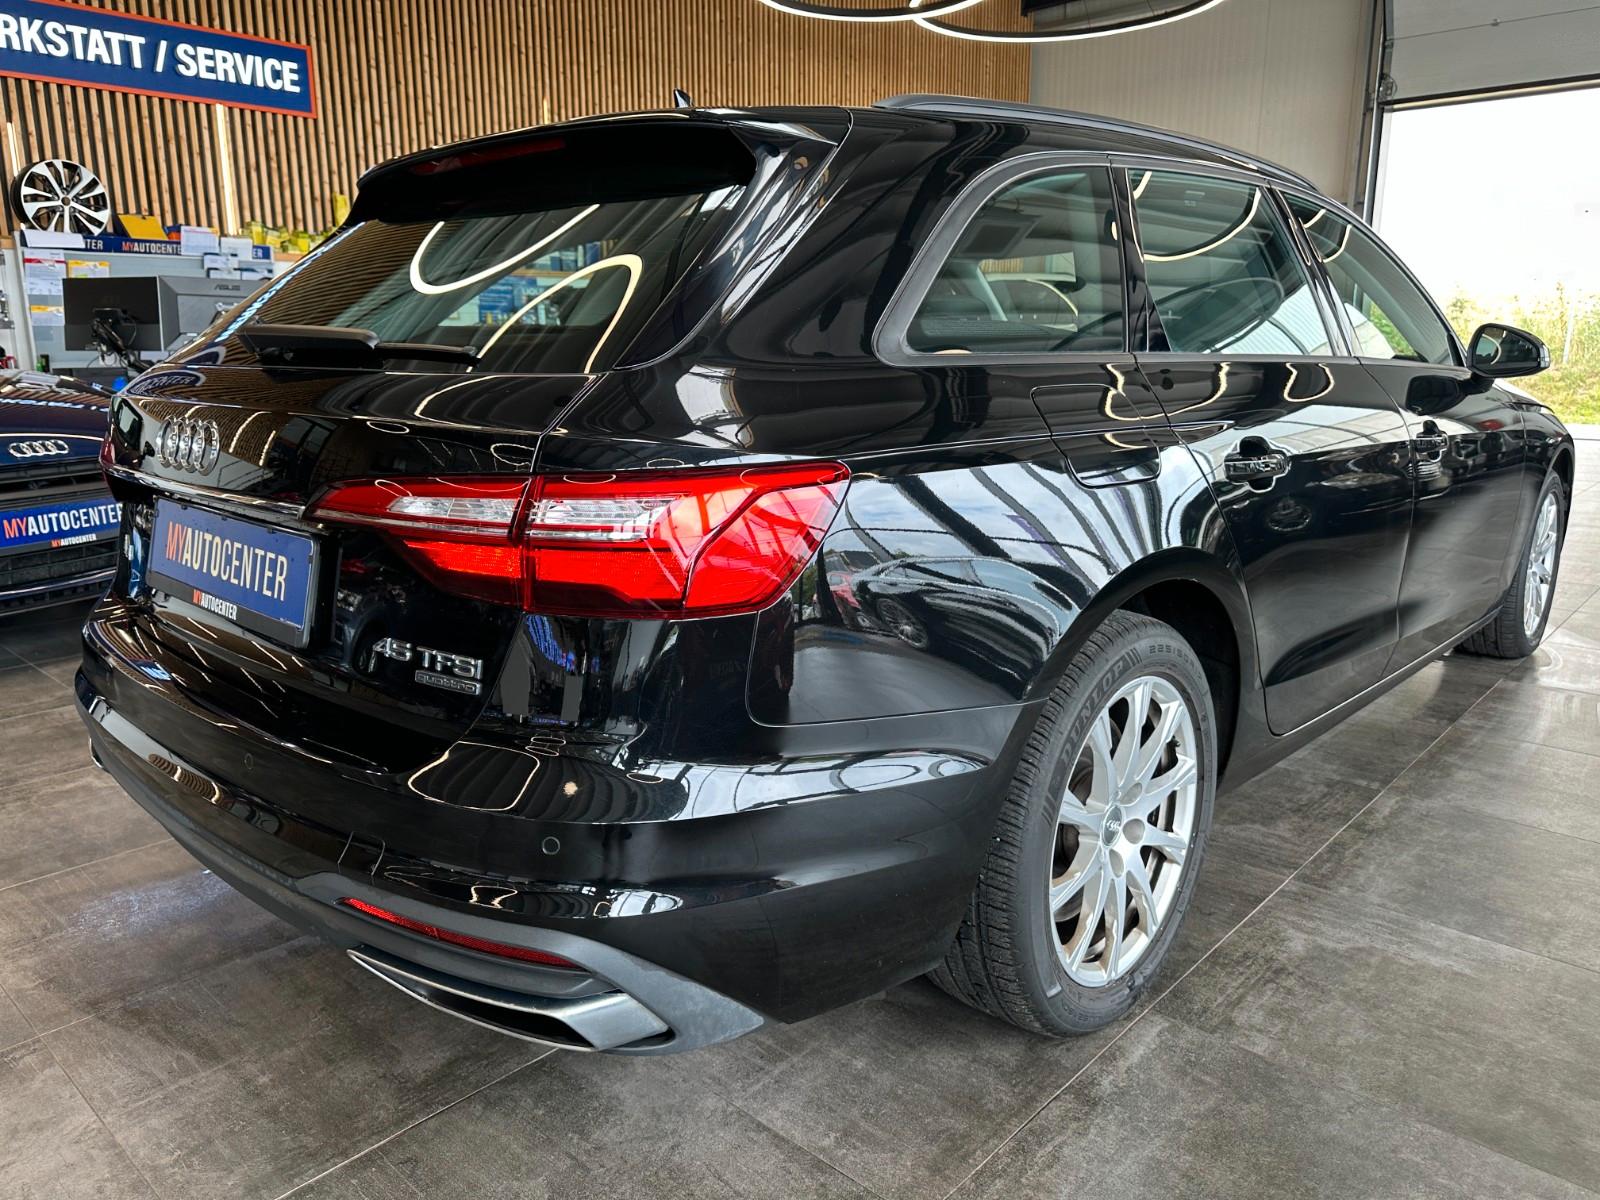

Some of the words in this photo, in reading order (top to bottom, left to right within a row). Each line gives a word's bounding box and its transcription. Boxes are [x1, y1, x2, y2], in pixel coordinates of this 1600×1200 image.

[0, 13, 145, 69] RKSTATT
[154, 40, 167, 73] /
[175, 42, 301, 93] SERVICE
[122, 241, 181, 254] MYAUTOCENTE
[214, 283, 241, 291] ASUS
[51, 533, 97, 547] MYAUTOCENTER
[166, 521, 288, 601] MYAUTOCENTER
[192, 589, 237, 621] MYAUTOCENTER
[371, 637, 412, 661] 45
[416, 646, 483, 680] TFSI
[1060, 659, 1124, 765] DUNLOP
